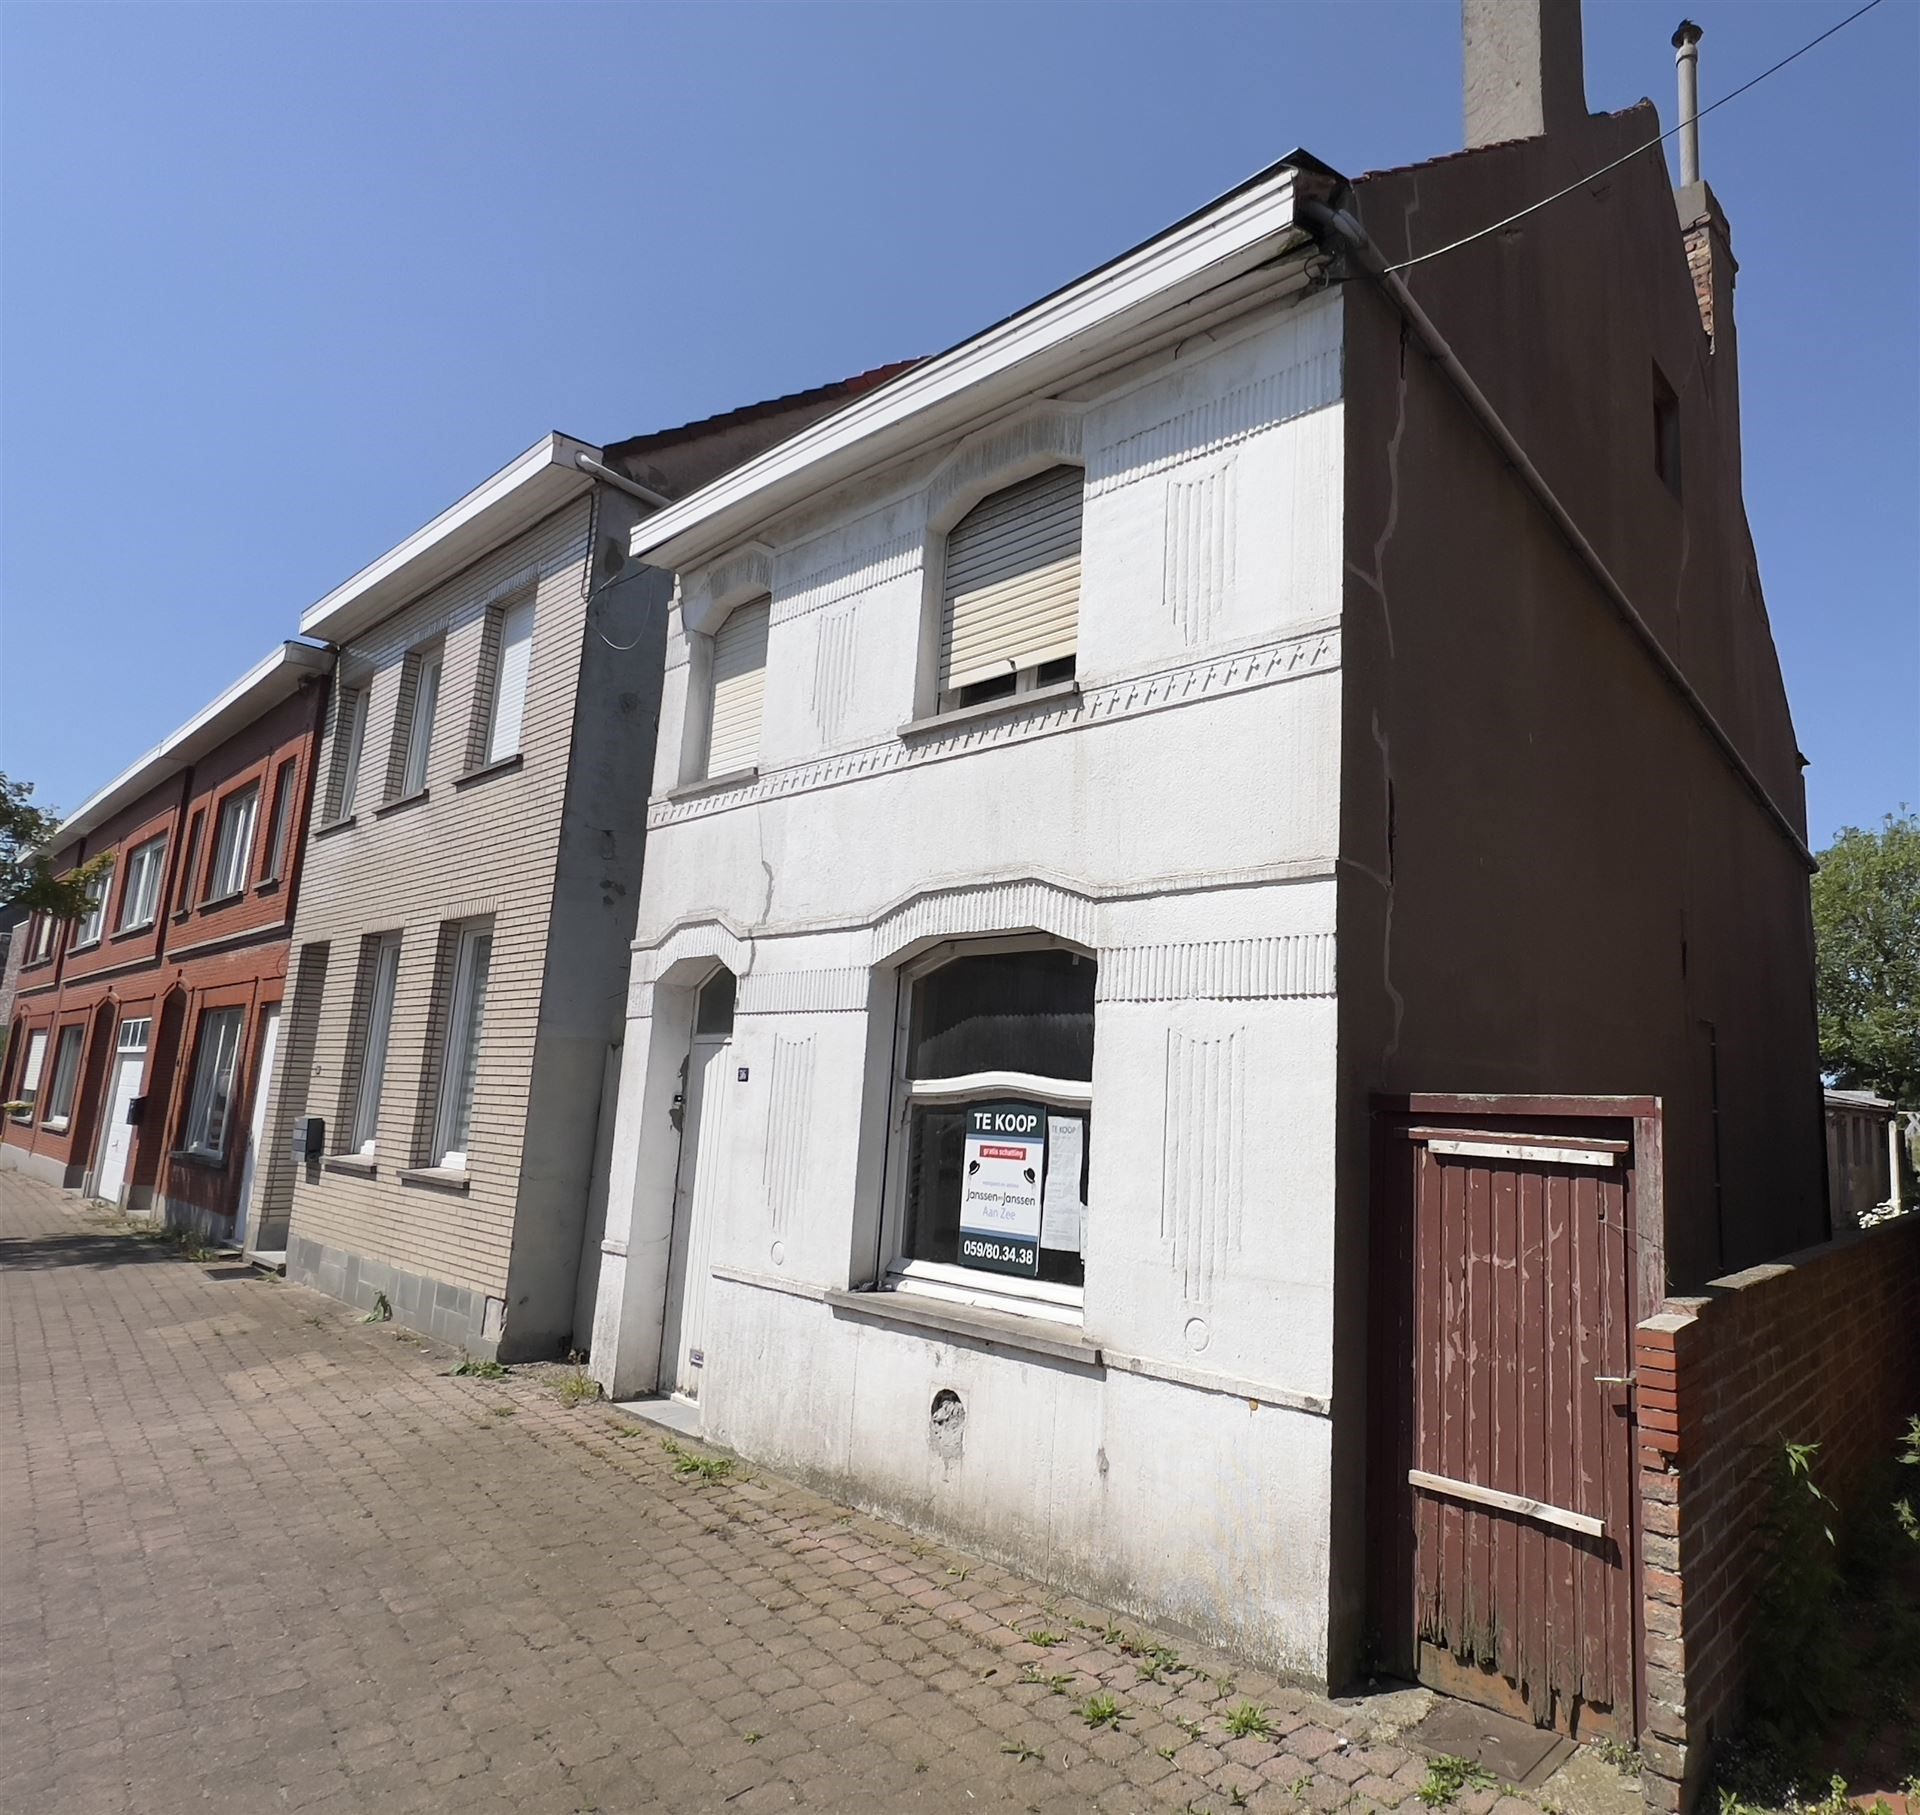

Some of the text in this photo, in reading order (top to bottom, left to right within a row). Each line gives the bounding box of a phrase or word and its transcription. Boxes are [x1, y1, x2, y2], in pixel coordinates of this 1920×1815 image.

[974, 1113, 1037, 1133] TE KOOP
[1060, 1126, 1076, 1135] KOOP
[982, 1206, 1016, 1220] Aan Zee
[963, 1240, 1034, 1265] 059/80.34.38
